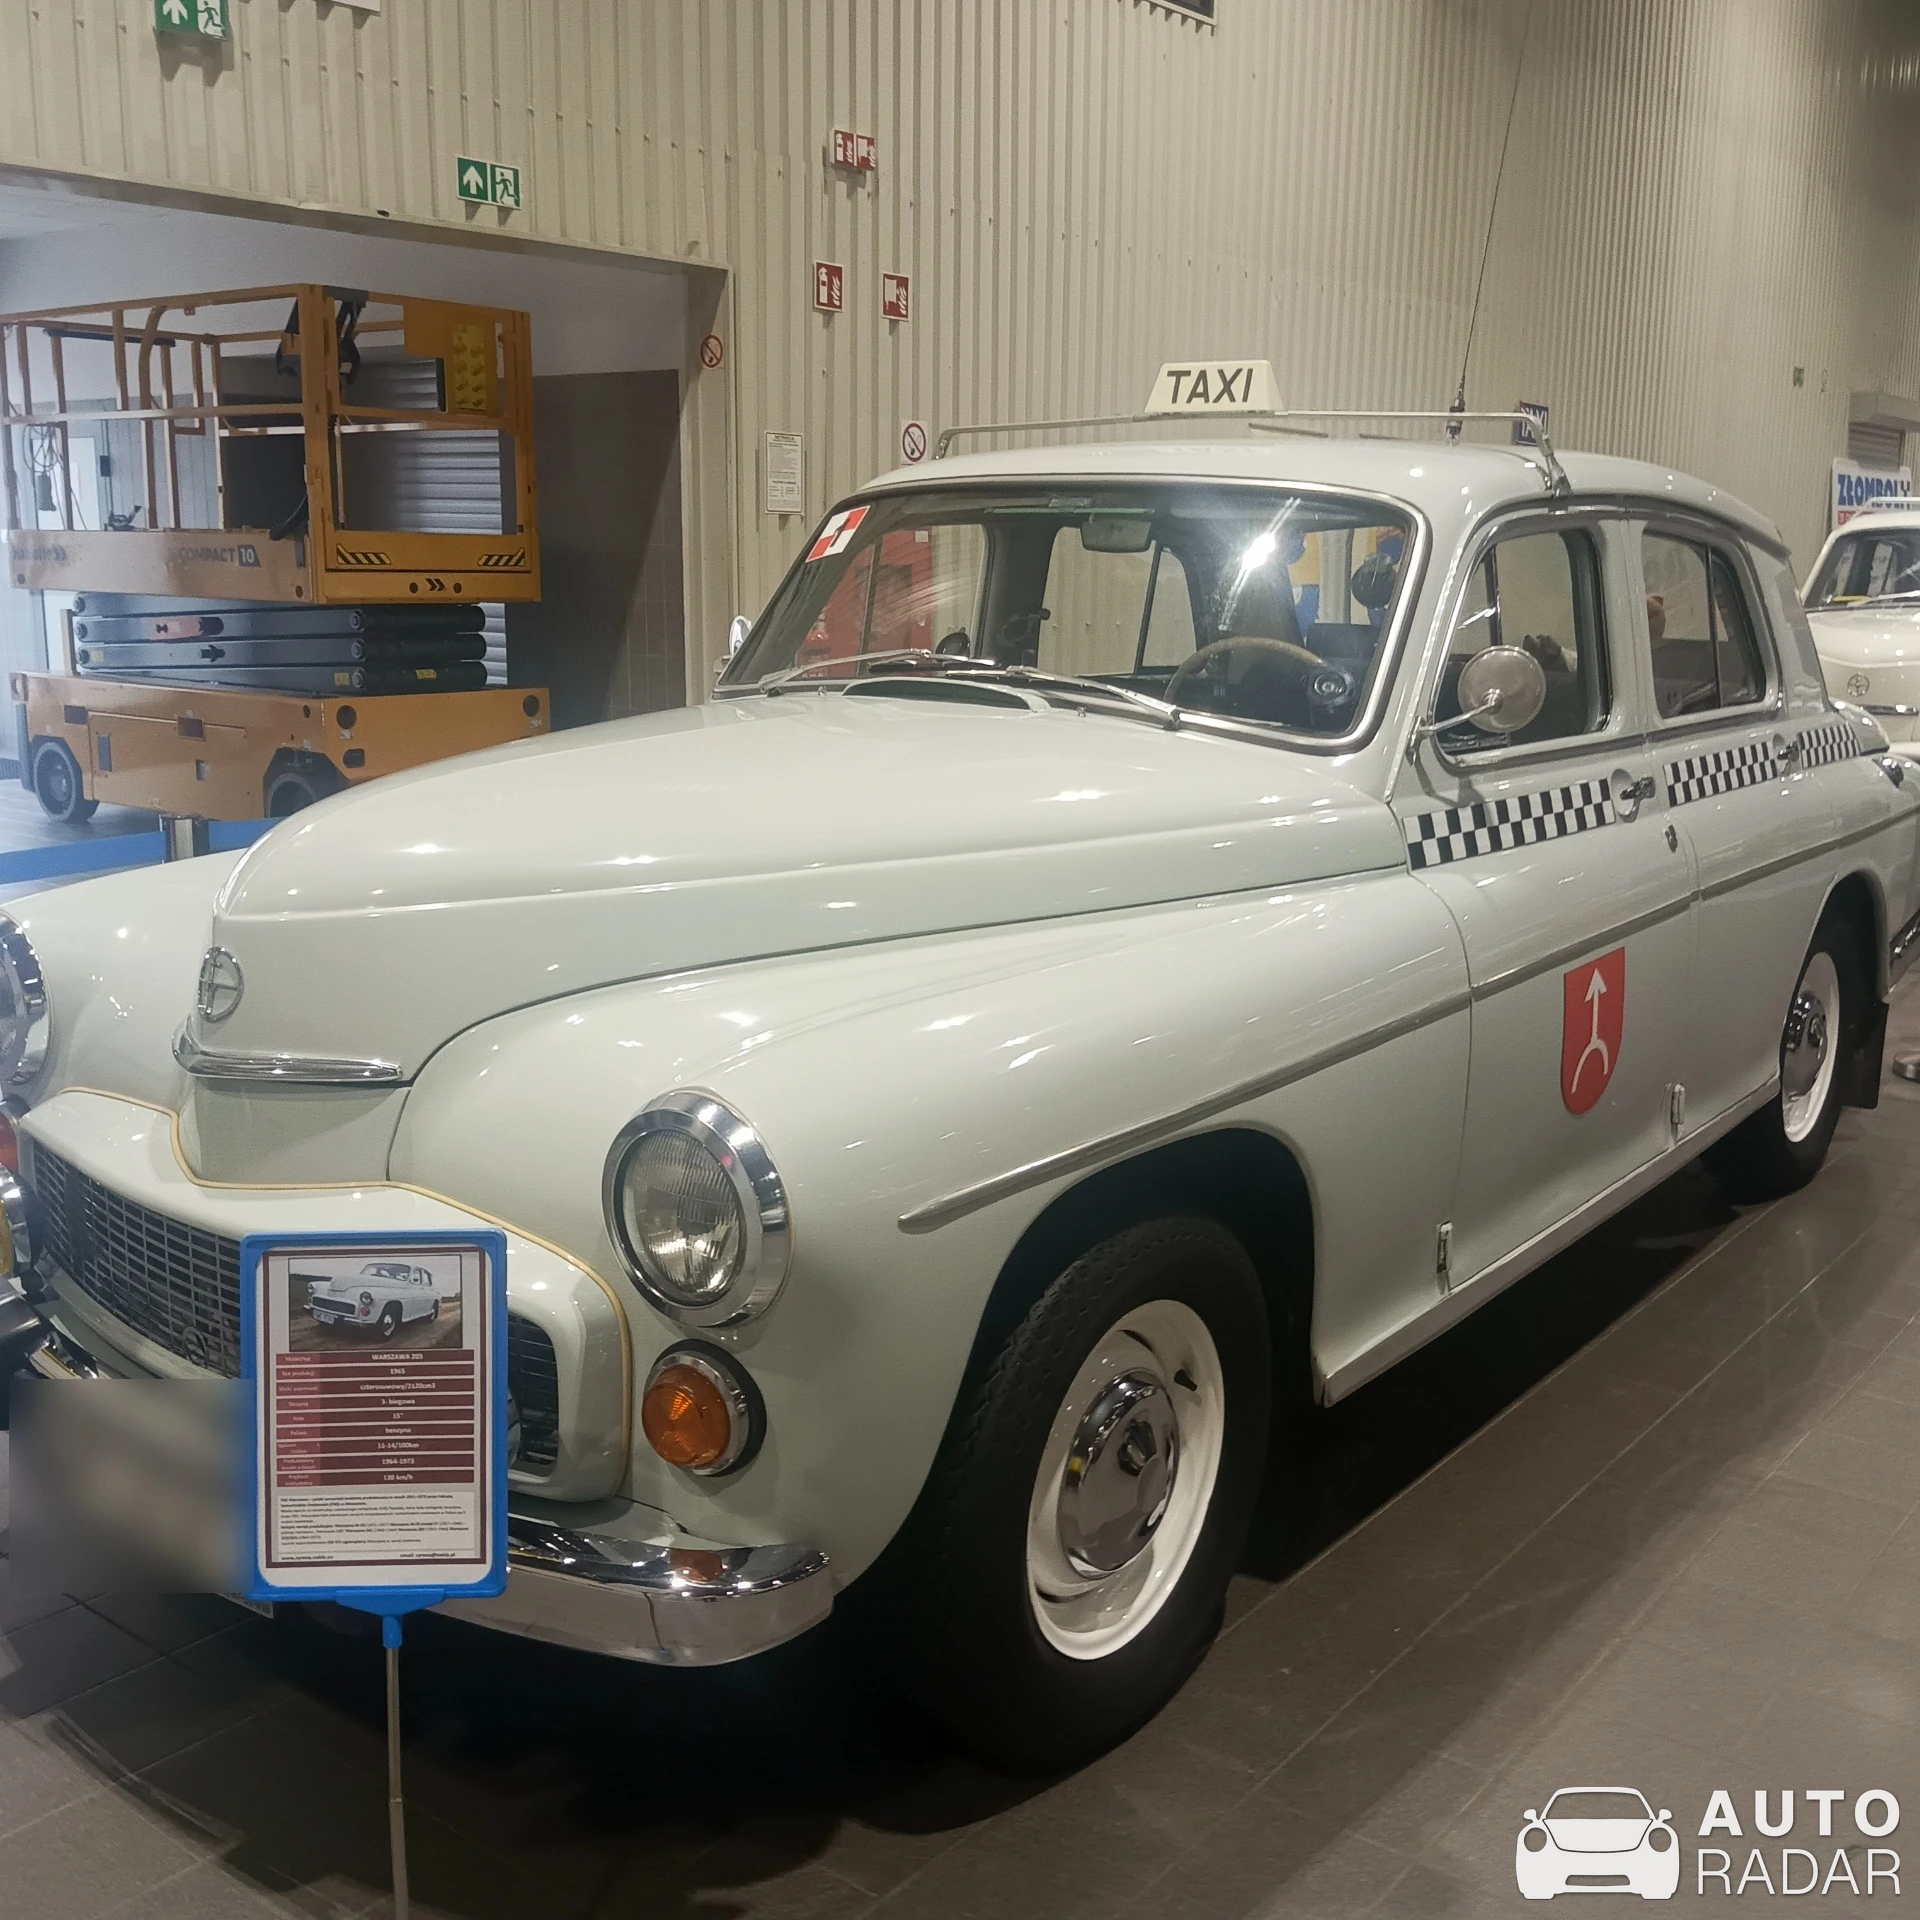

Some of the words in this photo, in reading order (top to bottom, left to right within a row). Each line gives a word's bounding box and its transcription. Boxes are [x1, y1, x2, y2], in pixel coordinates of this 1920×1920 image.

[1167, 368, 1253, 404] TAXI
[240, 548, 256, 563] 10
[381, 1457, 415, 1465] 1964-1973
[396, 1473, 414, 1481] km/h
